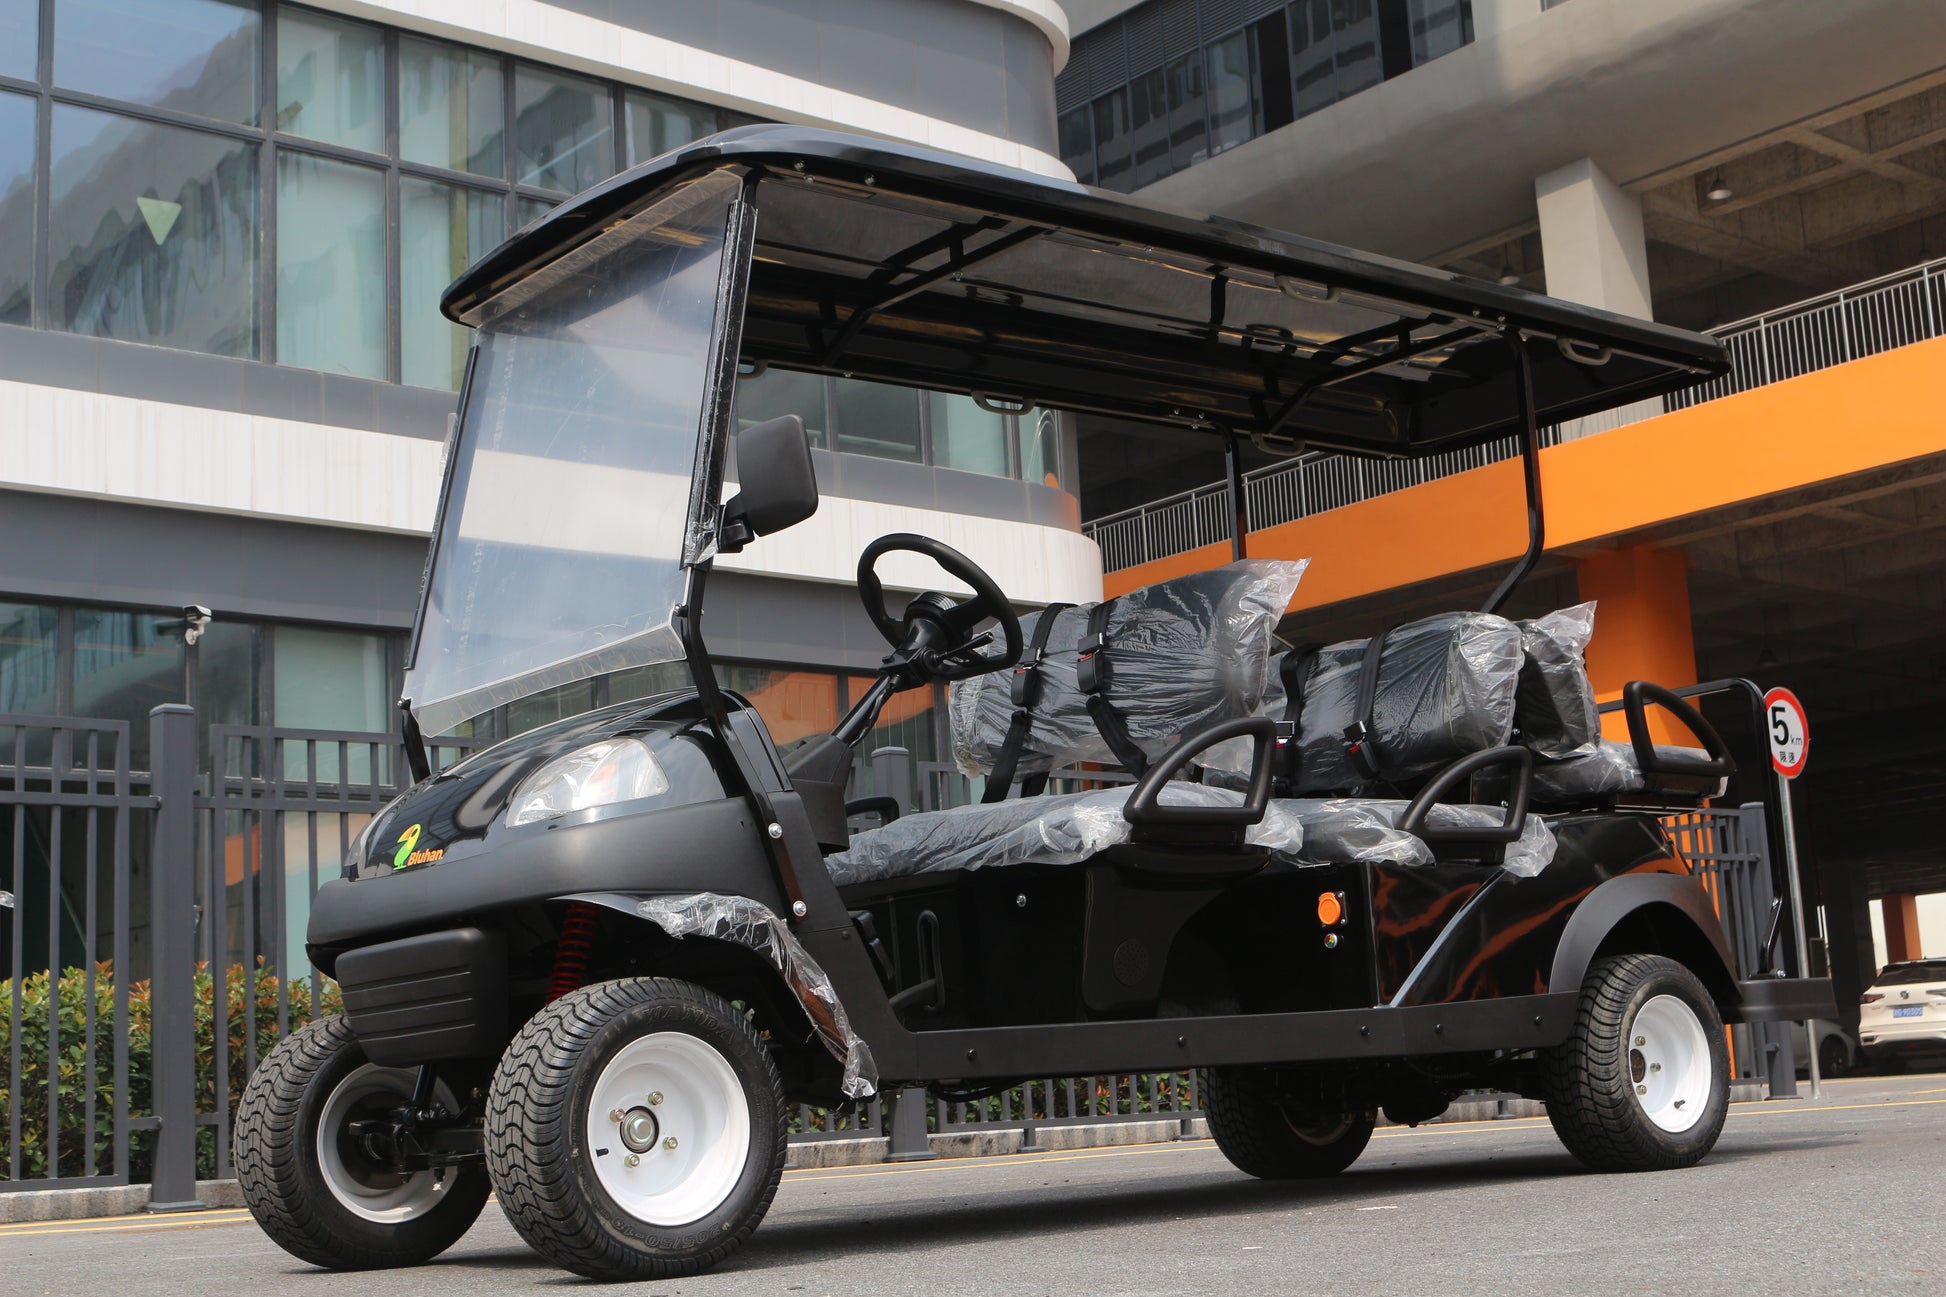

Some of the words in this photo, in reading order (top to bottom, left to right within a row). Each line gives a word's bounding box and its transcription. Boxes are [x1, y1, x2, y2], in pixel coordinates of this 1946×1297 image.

[1771, 706, 1789, 745] 5
[1790, 734, 1802, 745] km
[407, 849, 443, 866] Bluhan
